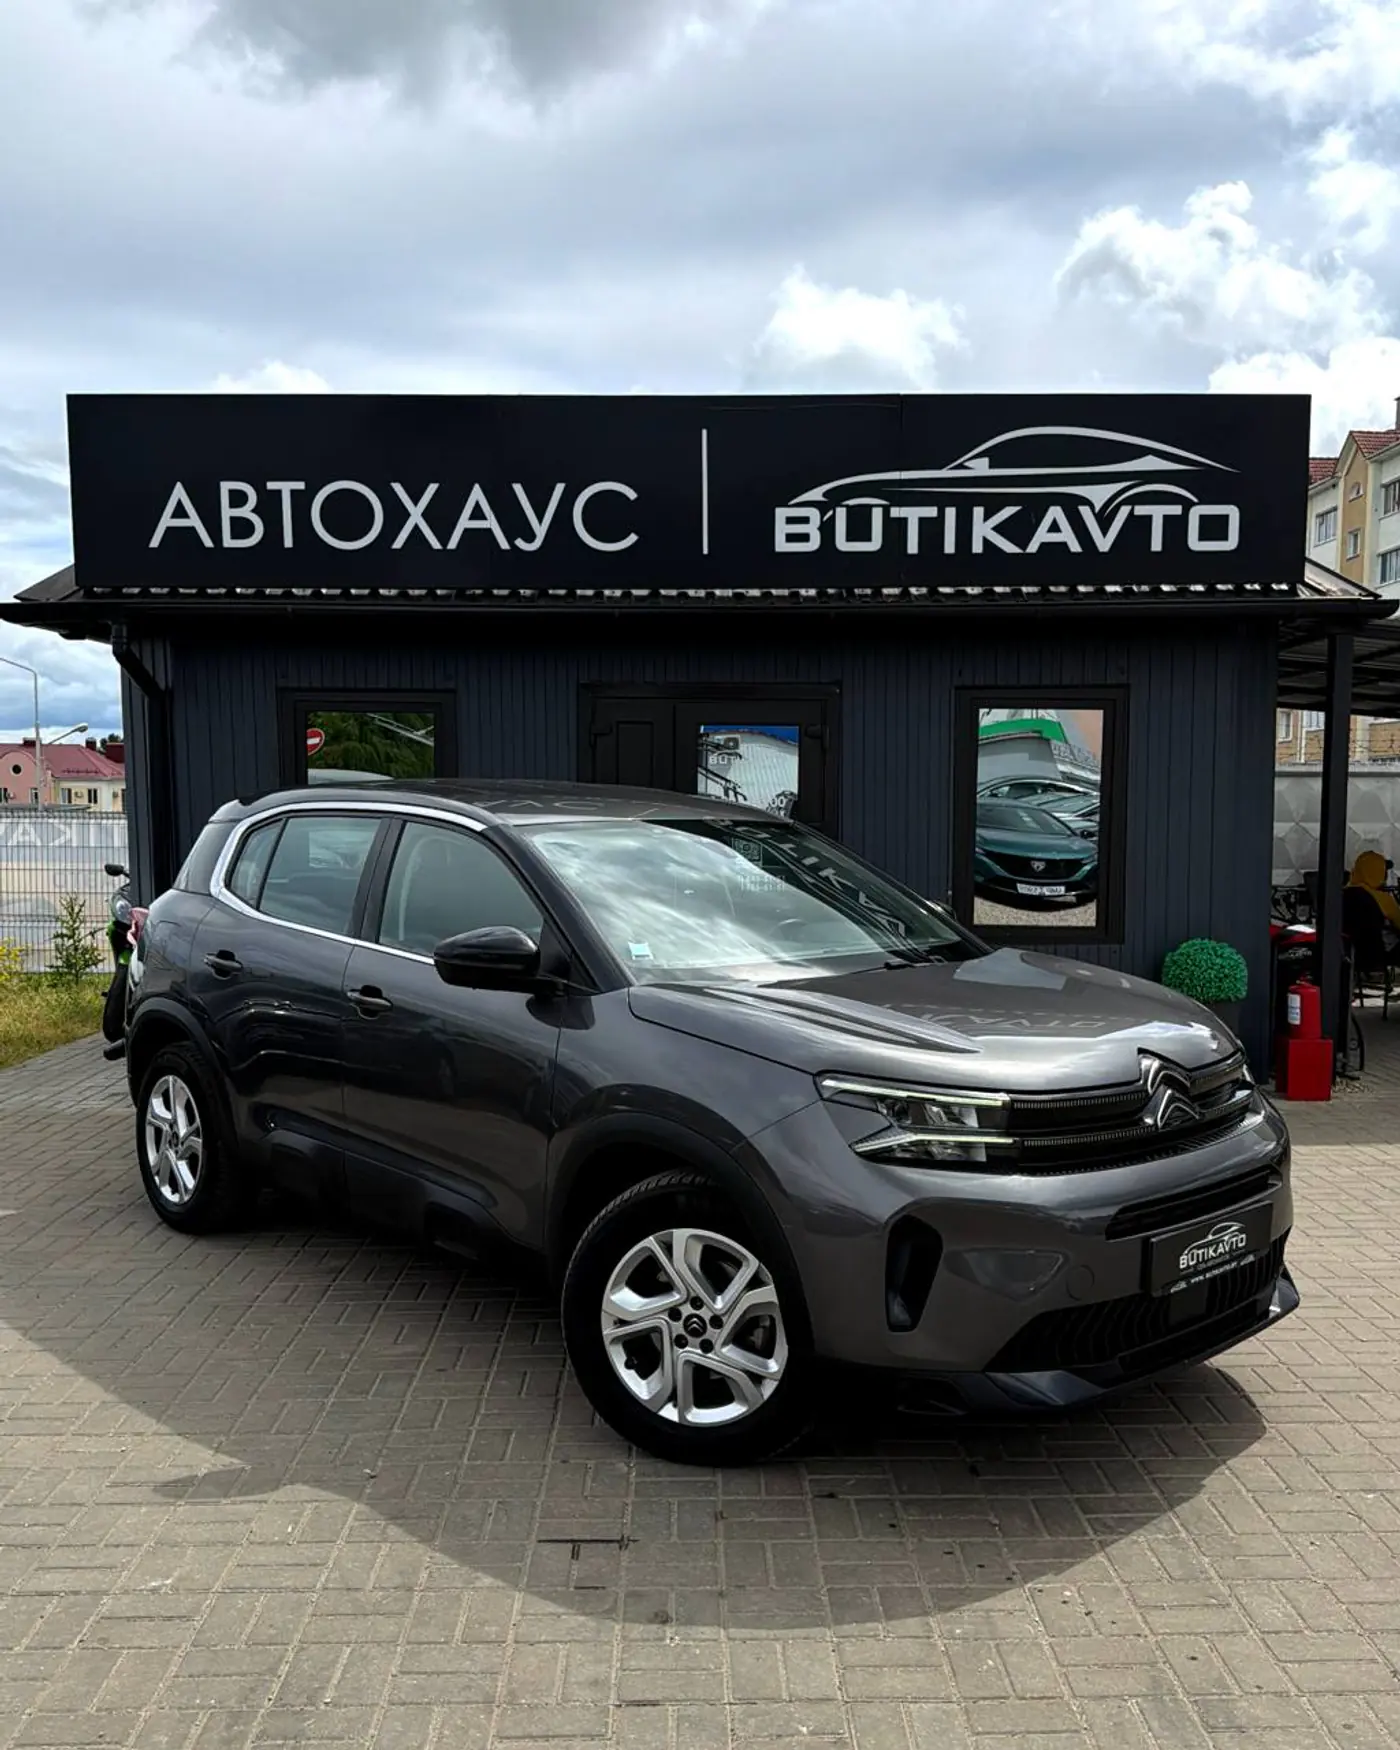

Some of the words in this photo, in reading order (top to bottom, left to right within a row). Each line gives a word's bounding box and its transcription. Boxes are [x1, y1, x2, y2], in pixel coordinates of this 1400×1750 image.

[149, 481, 638, 551] АВТОХАУС
[775, 504, 1239, 554] BUTIKAVTO
[1179, 1234, 1247, 1269] BUTIKAVTO
